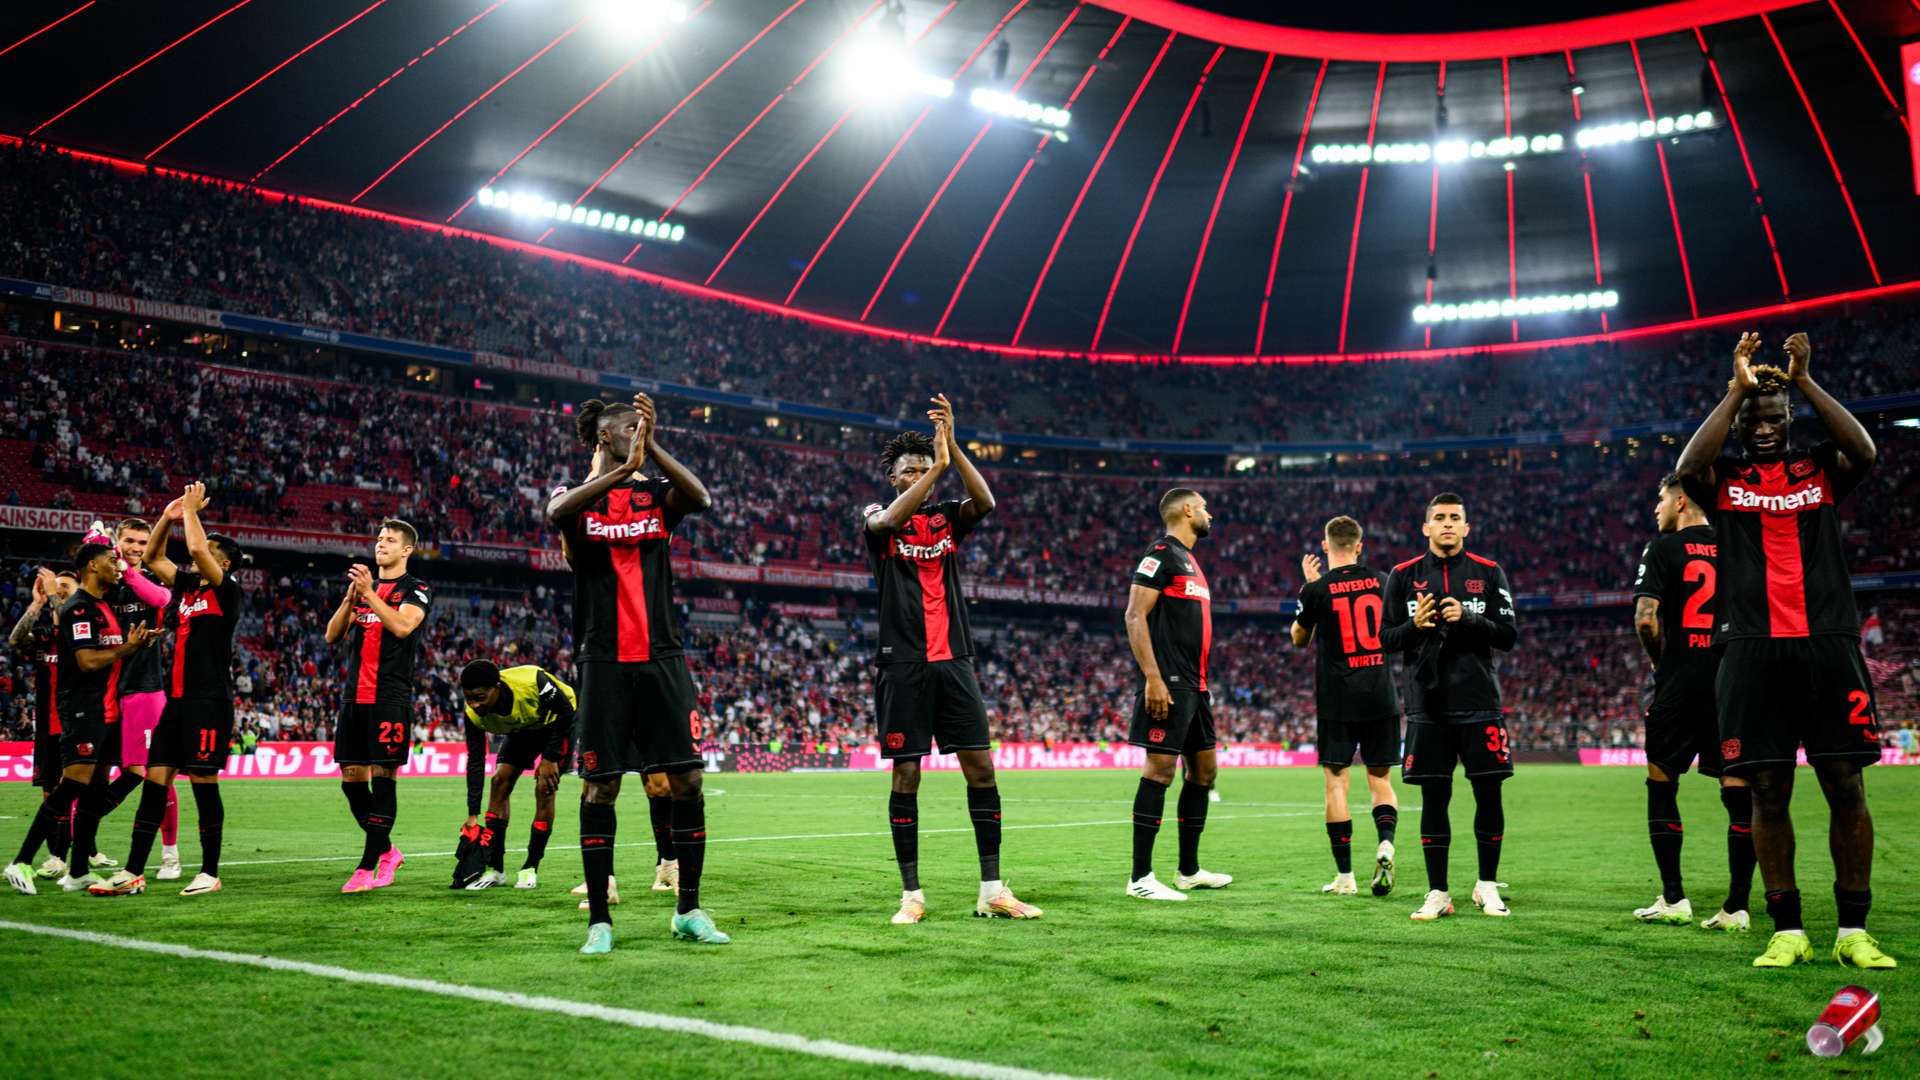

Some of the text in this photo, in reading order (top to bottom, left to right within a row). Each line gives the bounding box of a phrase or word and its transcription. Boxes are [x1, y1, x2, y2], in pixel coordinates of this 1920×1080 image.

[96, 294, 131, 311] BULLS
[1728, 484, 1823, 511] Barmenia
[0, 506, 95, 531] AINSACKER
[895, 535, 952, 559] Barmeni
[1684, 544, 1717, 557] BAYE
[1329, 578, 1380, 595] BAYER 04
[1682, 559, 1717, 629] 2
[1332, 593, 1383, 654] 10
[1348, 653, 1384, 668] WIRTZ
[379, 722, 404, 743] 23
[690, 710, 702, 740] 6
[200, 729, 216, 752] 11
[1486, 726, 1510, 753] 32
